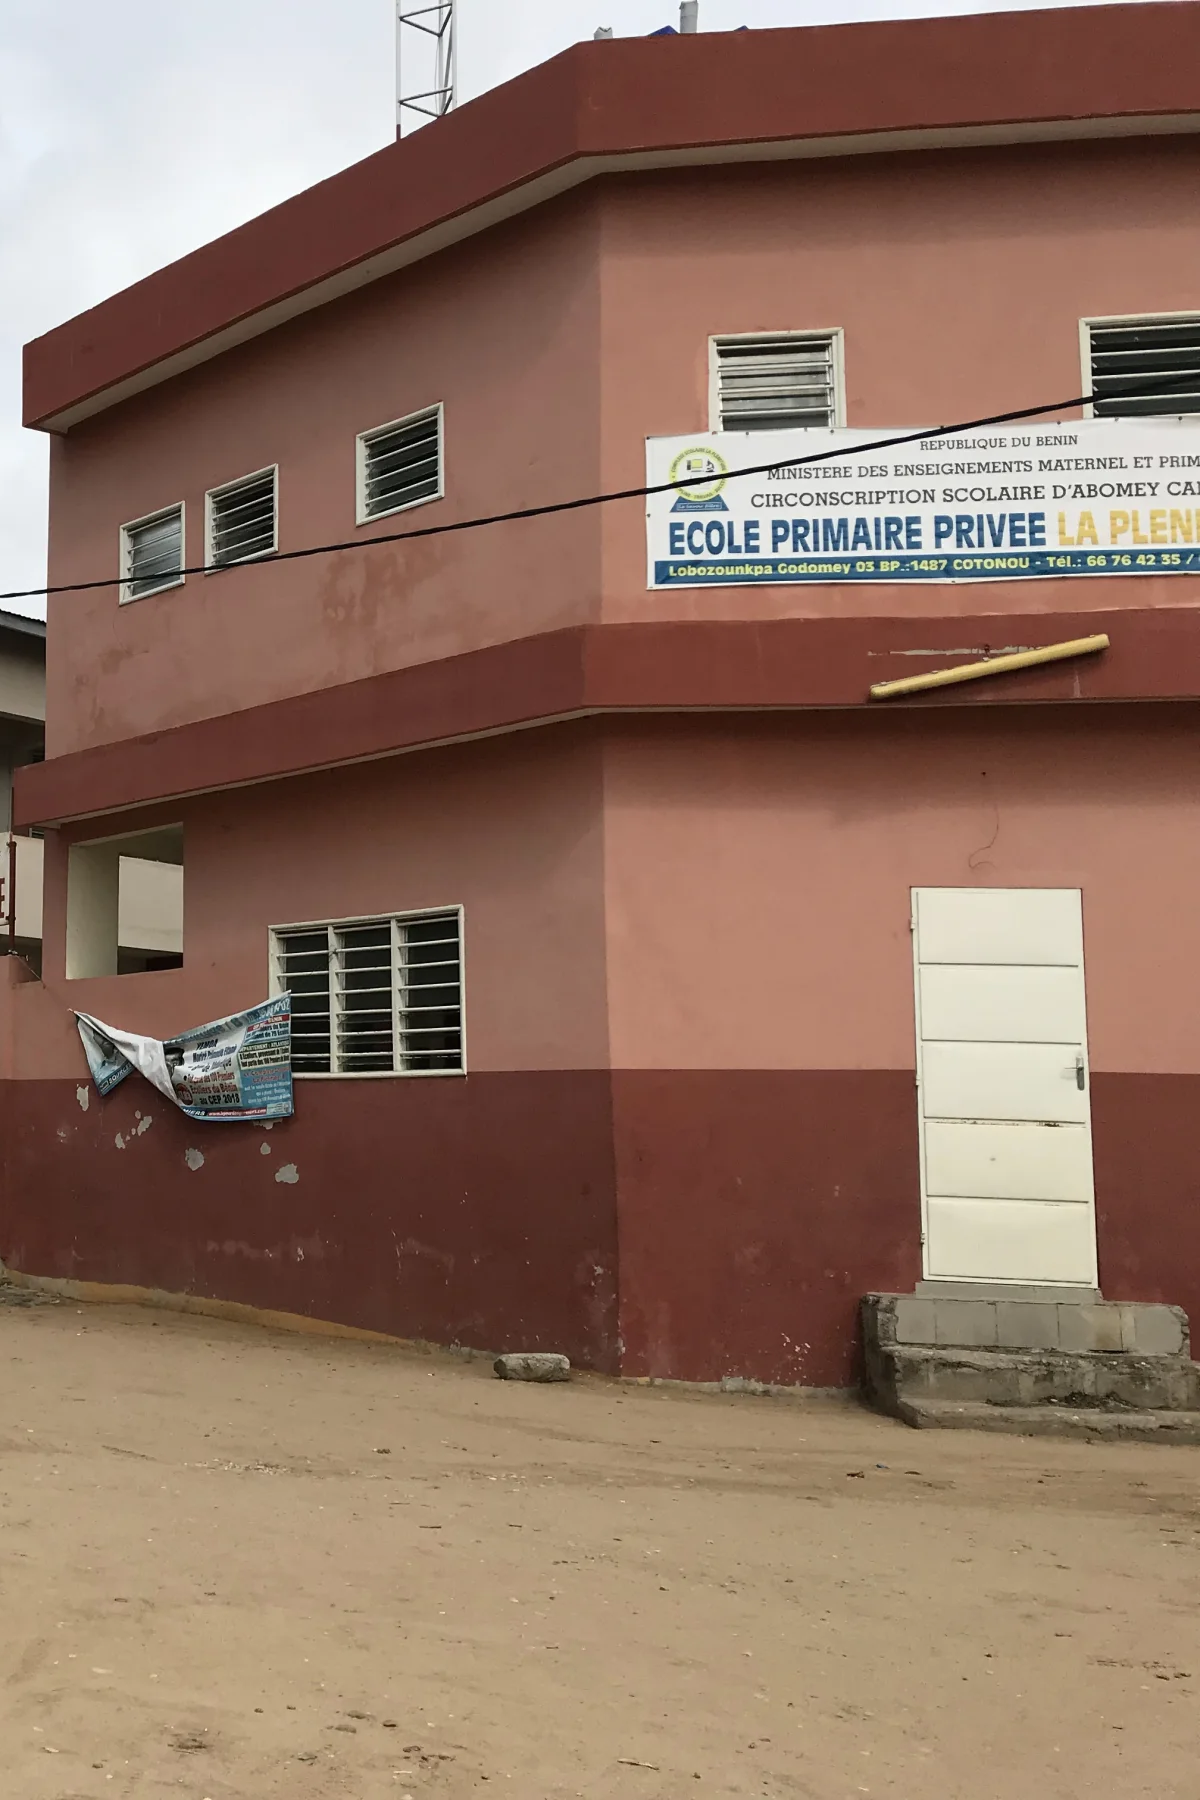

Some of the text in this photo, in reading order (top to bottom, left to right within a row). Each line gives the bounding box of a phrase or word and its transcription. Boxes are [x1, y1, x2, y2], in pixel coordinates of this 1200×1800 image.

[919, 434, 1079, 451] REPUBLIQUE DU BENIN
[767, 466, 853, 481] MINISTERE
[858, 464, 889, 478] DES
[893, 460, 1033, 477] ENSEIGNEMENTS
[1038, 456, 1128, 472] MATERNEL
[1133, 456, 1153, 469] ET
[750, 481, 1200, 508] CIRCONSCRIPTION SCOLAIRE D'ABOMEY CA
[669, 519, 761, 556] ECOLE
[771, 516, 923, 553] PRIMAIRE
[934, 511, 1047, 550] PRIVEE
[1058, 510, 1099, 546] LA
[669, 560, 773, 578] Lobozounkpa
[777, 561, 850, 577] Godomey
[855, 560, 875, 573] 03
[953, 557, 1030, 572] COTONOU
[1086, 555, 1107, 567] 66
[1111, 554, 1132, 567] 76
[1136, 553, 1156, 566] 42
[1161, 553, 1181, 565] 35
[208, 1095, 221, 1105] CEP
[222, 1093, 240, 1104] 2018
